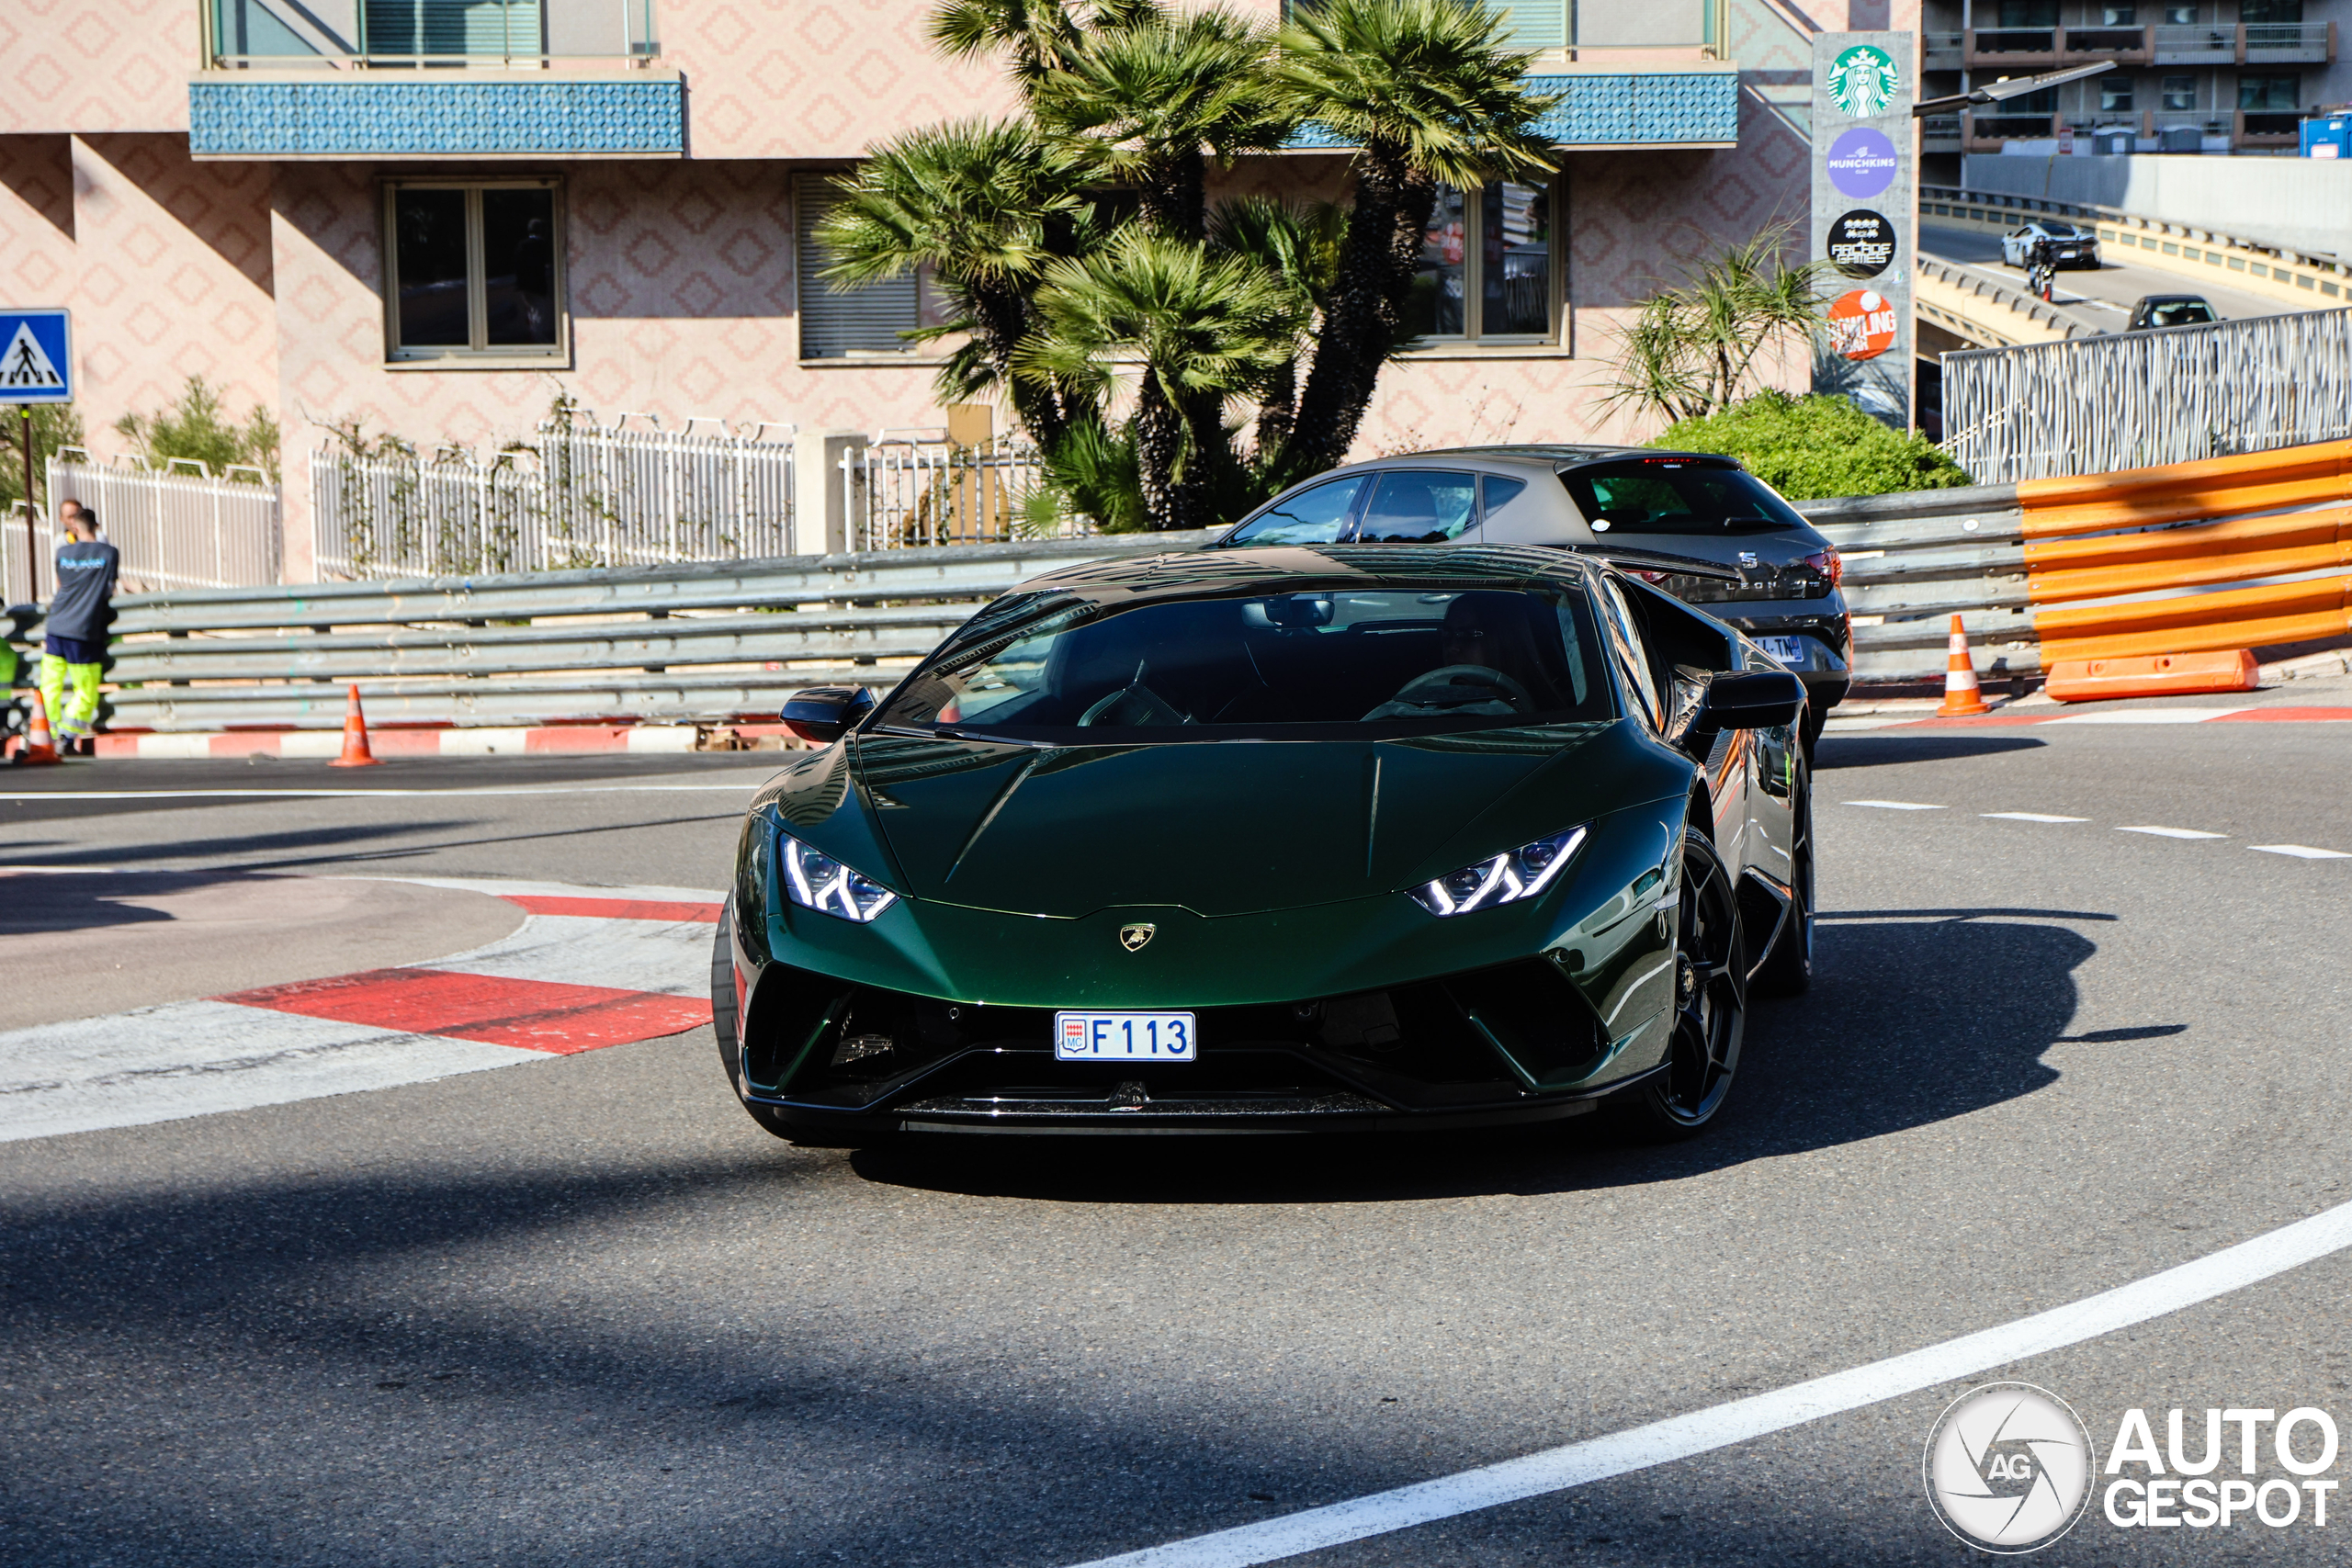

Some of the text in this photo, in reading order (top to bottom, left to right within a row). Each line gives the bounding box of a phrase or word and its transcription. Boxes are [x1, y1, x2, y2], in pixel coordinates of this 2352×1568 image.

[1828, 158, 1895, 168] MUNCHKINS
[1831, 243, 1892, 255] ARCADE
[1836, 254, 1887, 265] GAMES
[1725, 581, 1778, 590] LEON
[1067, 1037, 1082, 1047] MC
[1092, 1020, 1187, 1055] F113
